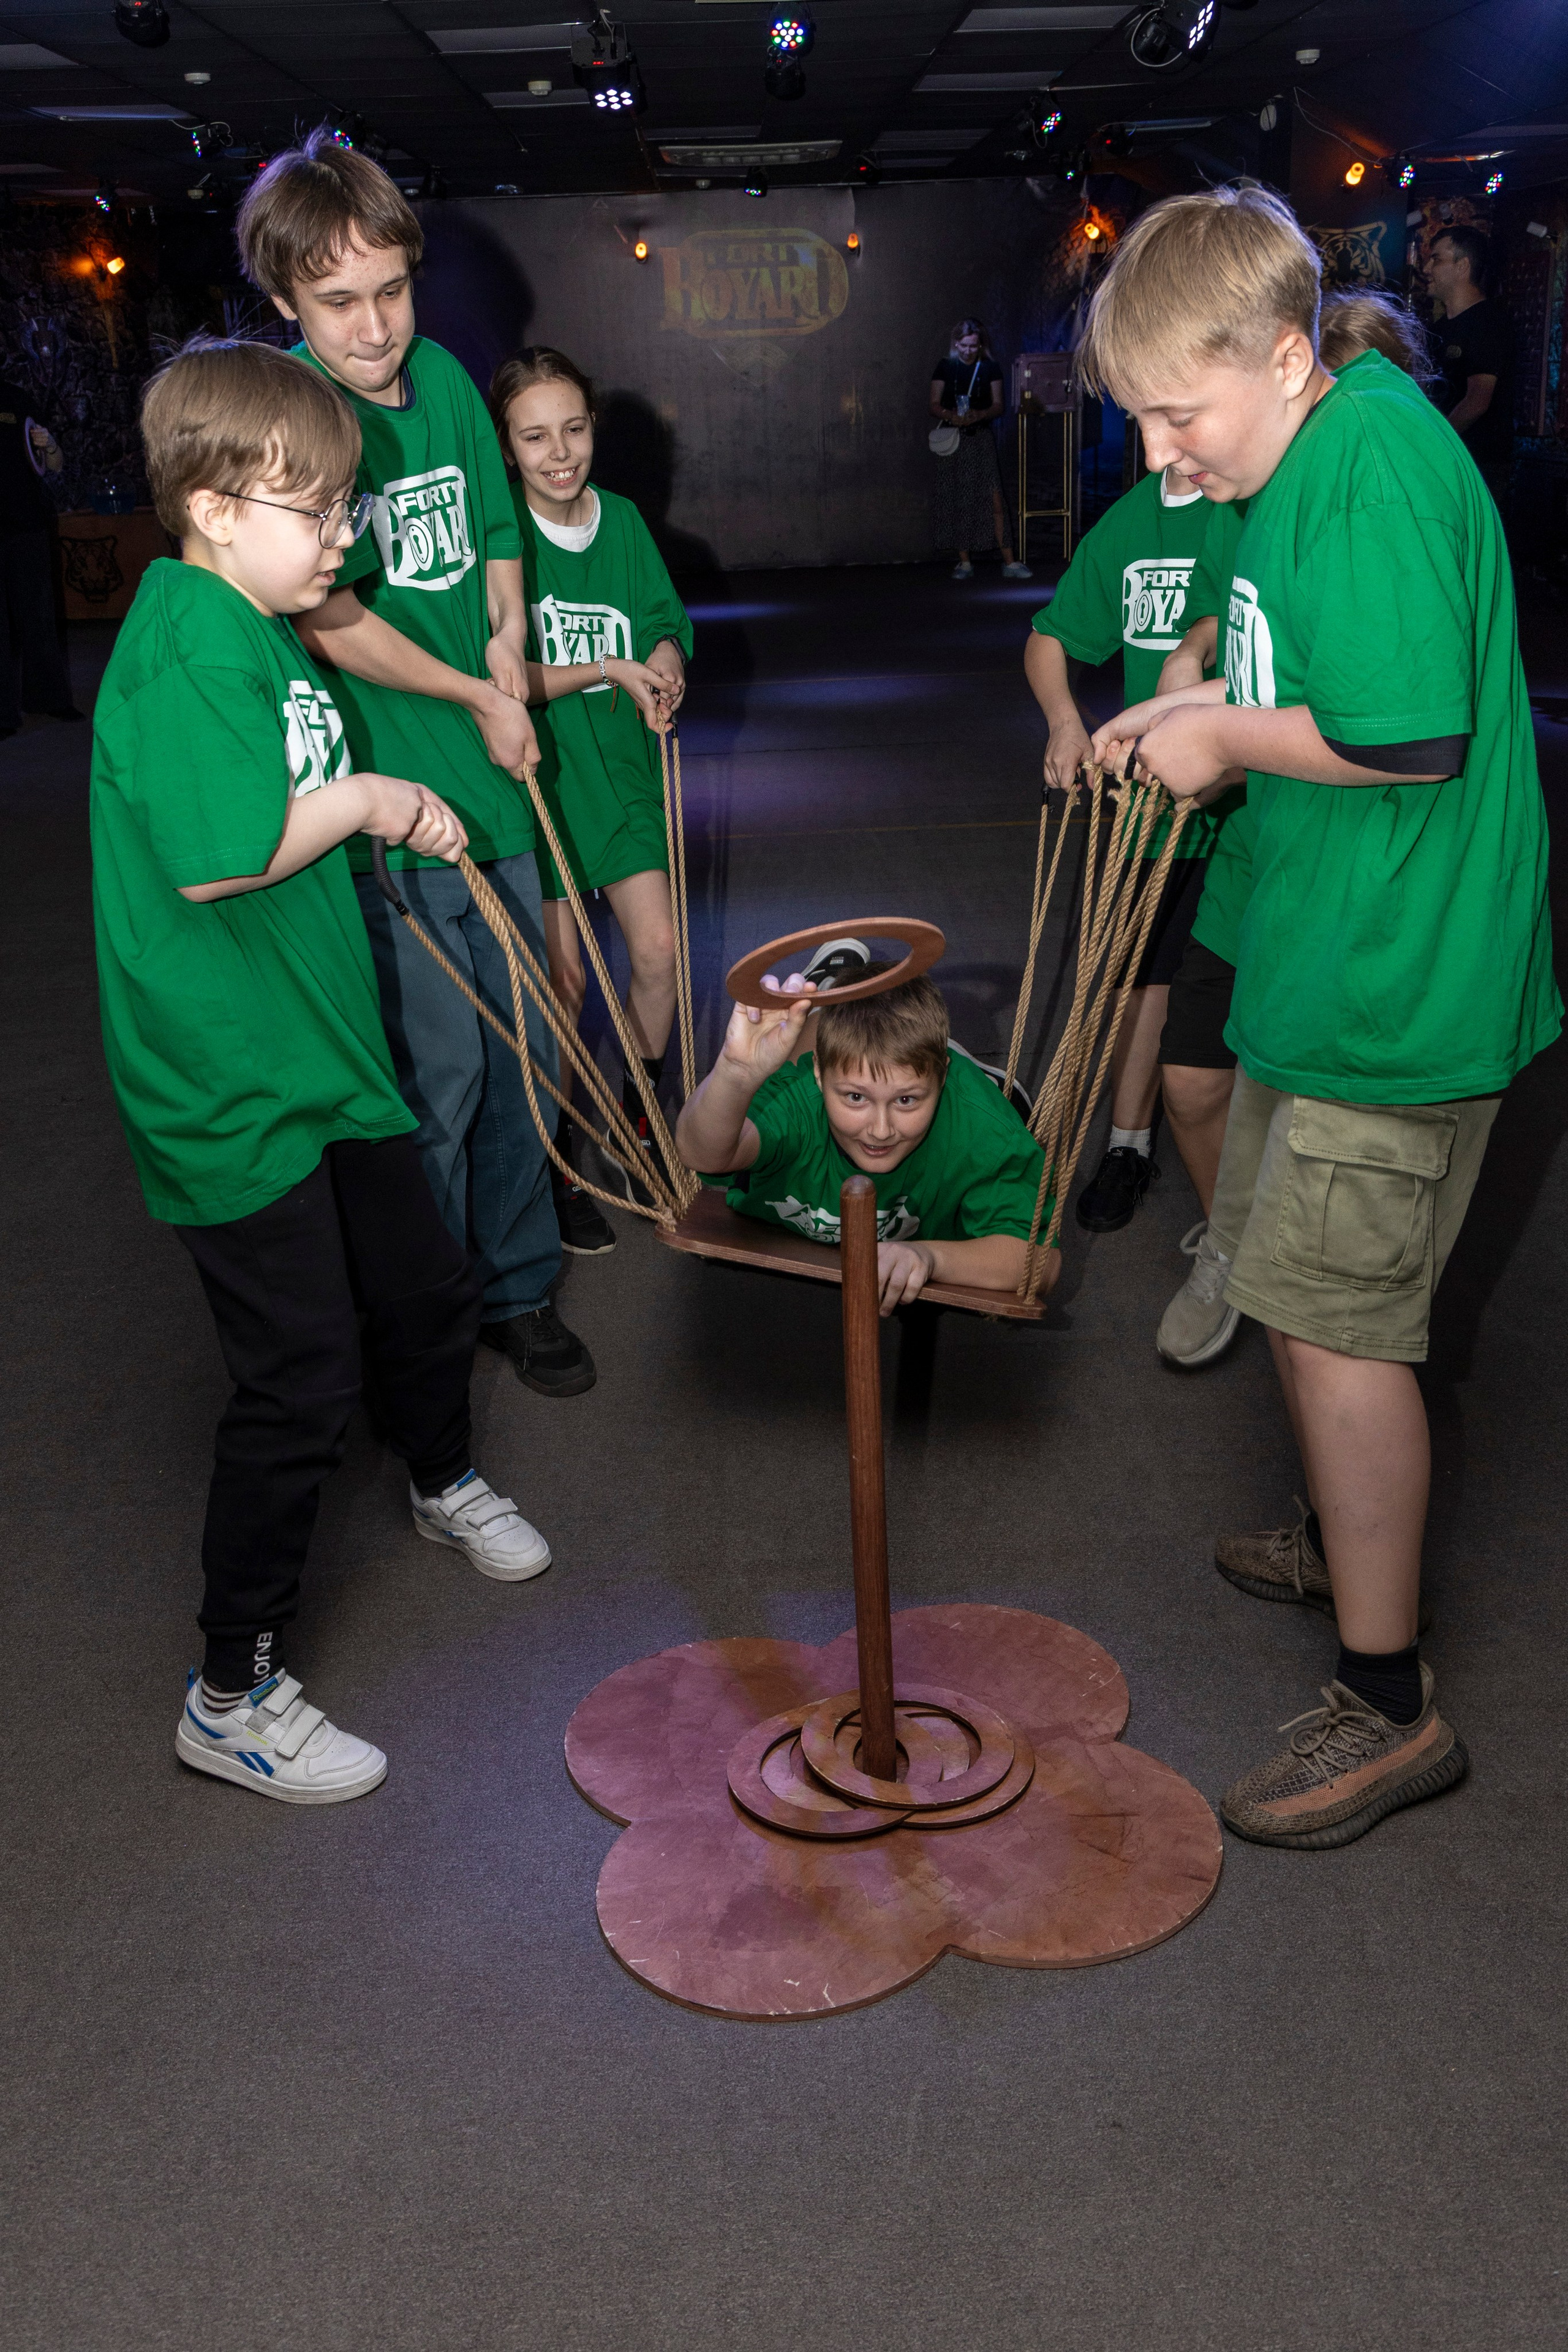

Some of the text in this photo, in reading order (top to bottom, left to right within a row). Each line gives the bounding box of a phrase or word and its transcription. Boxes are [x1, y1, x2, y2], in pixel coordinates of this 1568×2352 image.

[396, 481, 452, 516] FORT
[1142, 570, 1193, 587] FOR
[1122, 571, 1189, 639] BOYA
[559, 612, 601, 631] ORT
